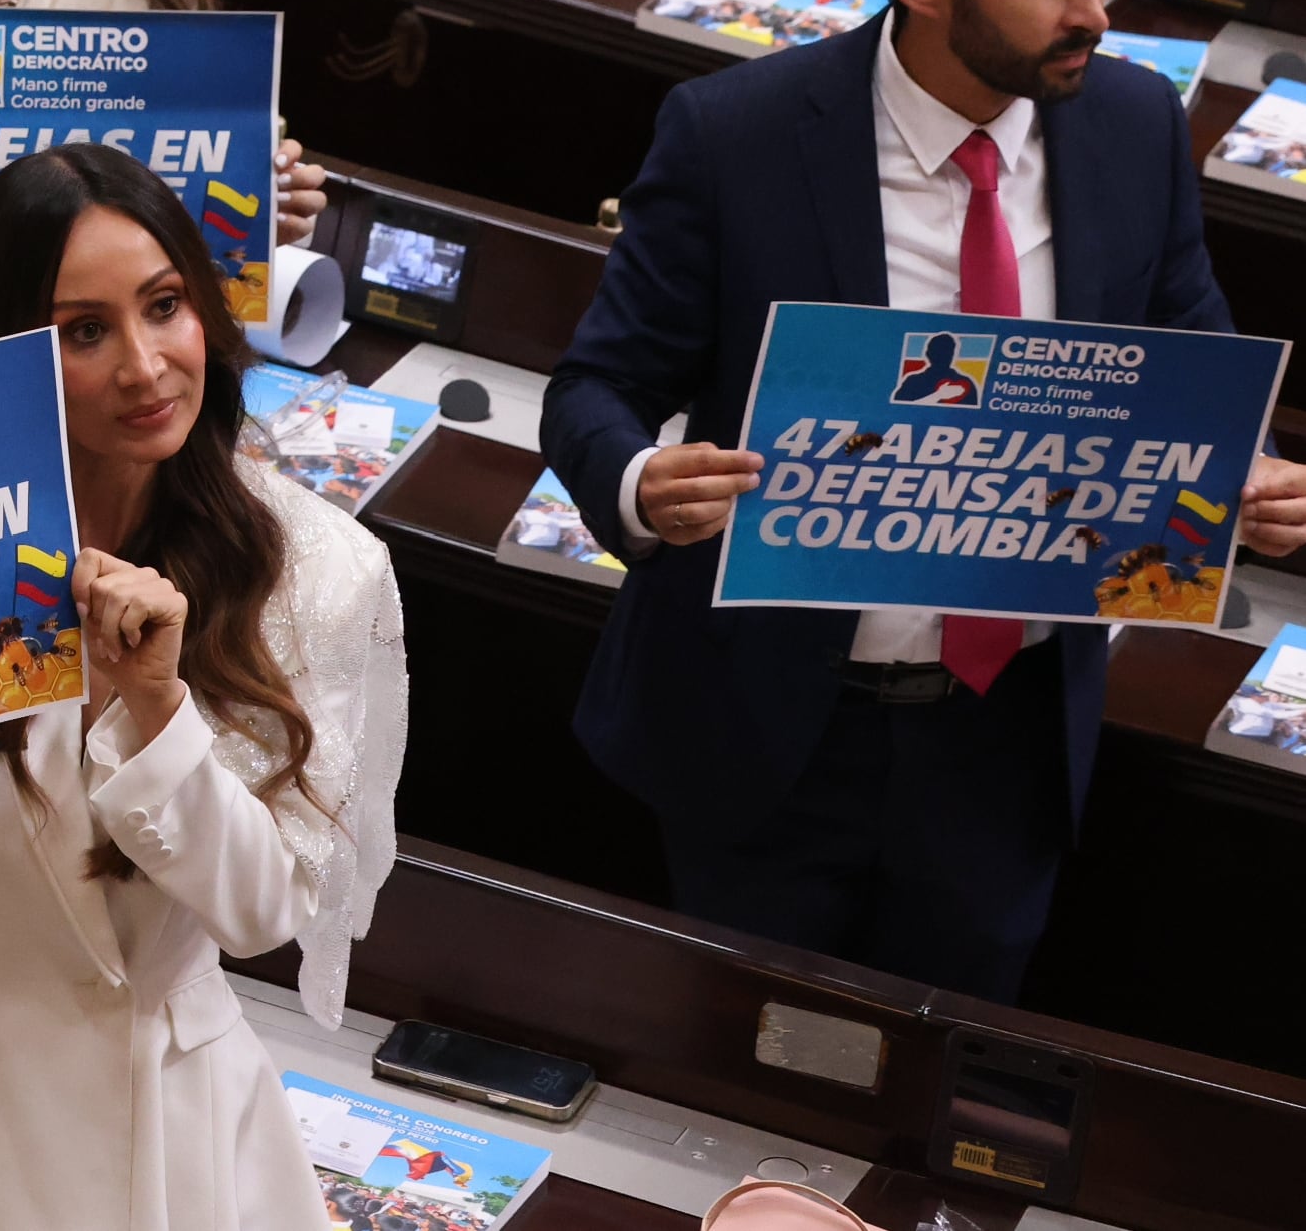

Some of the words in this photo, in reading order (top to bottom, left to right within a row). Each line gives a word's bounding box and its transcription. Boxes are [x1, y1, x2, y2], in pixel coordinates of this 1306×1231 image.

[11, 25, 148, 53] CENTRO
[12, 54, 147, 72] DEMOCRÁTICO
[11, 77, 59, 93] Mano
[62, 77, 107, 93] firme
[11, 94, 83, 109] Corazón
[86, 96, 145, 112] grande
[149, 130, 231, 172] EN
[1001, 335, 1145, 369] CENTRO
[997, 361, 1140, 384] DEMOCRÁTICO
[992, 381, 1042, 399] Mano
[1046, 383, 1093, 401] firme
[989, 397, 1064, 416] Corazón
[1067, 403, 1130, 421] grande
[773, 417, 859, 460] 47
[863, 423, 1111, 476] ABEJAS
[1120, 439, 1214, 482] EN
[763, 462, 1050, 518] DEFENSA
[1064, 479, 1159, 524] DE
[759, 506, 1091, 565] COLOMBIA
[332, 1094, 392, 1116] INFORME
[393, 1113, 411, 1122] AL
[415, 1120, 488, 1145] CONGRESO
[408, 1132, 439, 1144] PETRO
